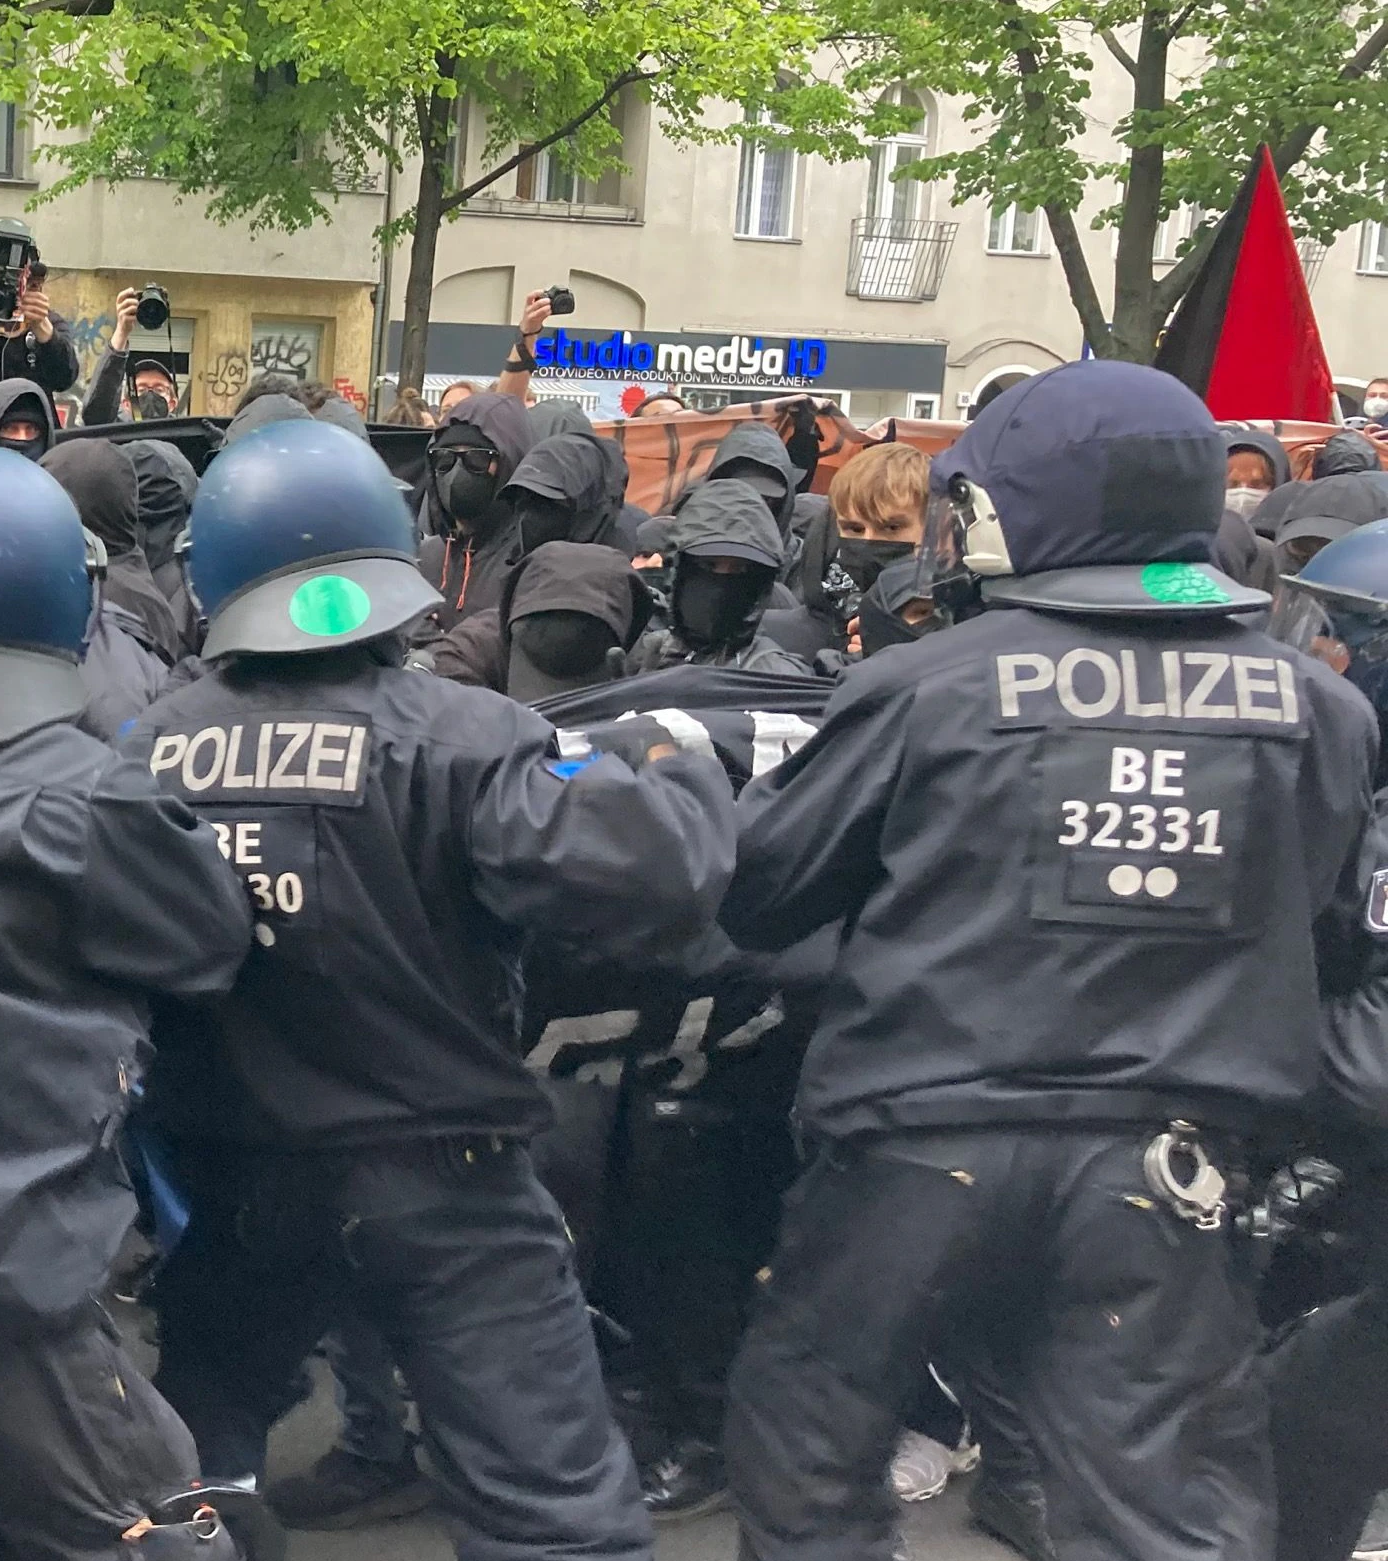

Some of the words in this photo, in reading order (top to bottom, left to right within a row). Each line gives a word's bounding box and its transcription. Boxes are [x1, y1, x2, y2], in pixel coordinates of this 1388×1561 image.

[534, 328, 654, 370] studio
[657, 335, 784, 376] medya
[787, 338, 827, 378] HD
[623, 369, 701, 383] PRODUKTION
[996, 647, 1299, 724] POLIZEI
[149, 721, 366, 792] POLIZEI
[1109, 746, 1187, 797] BE
[1058, 799, 1224, 855] 32331
